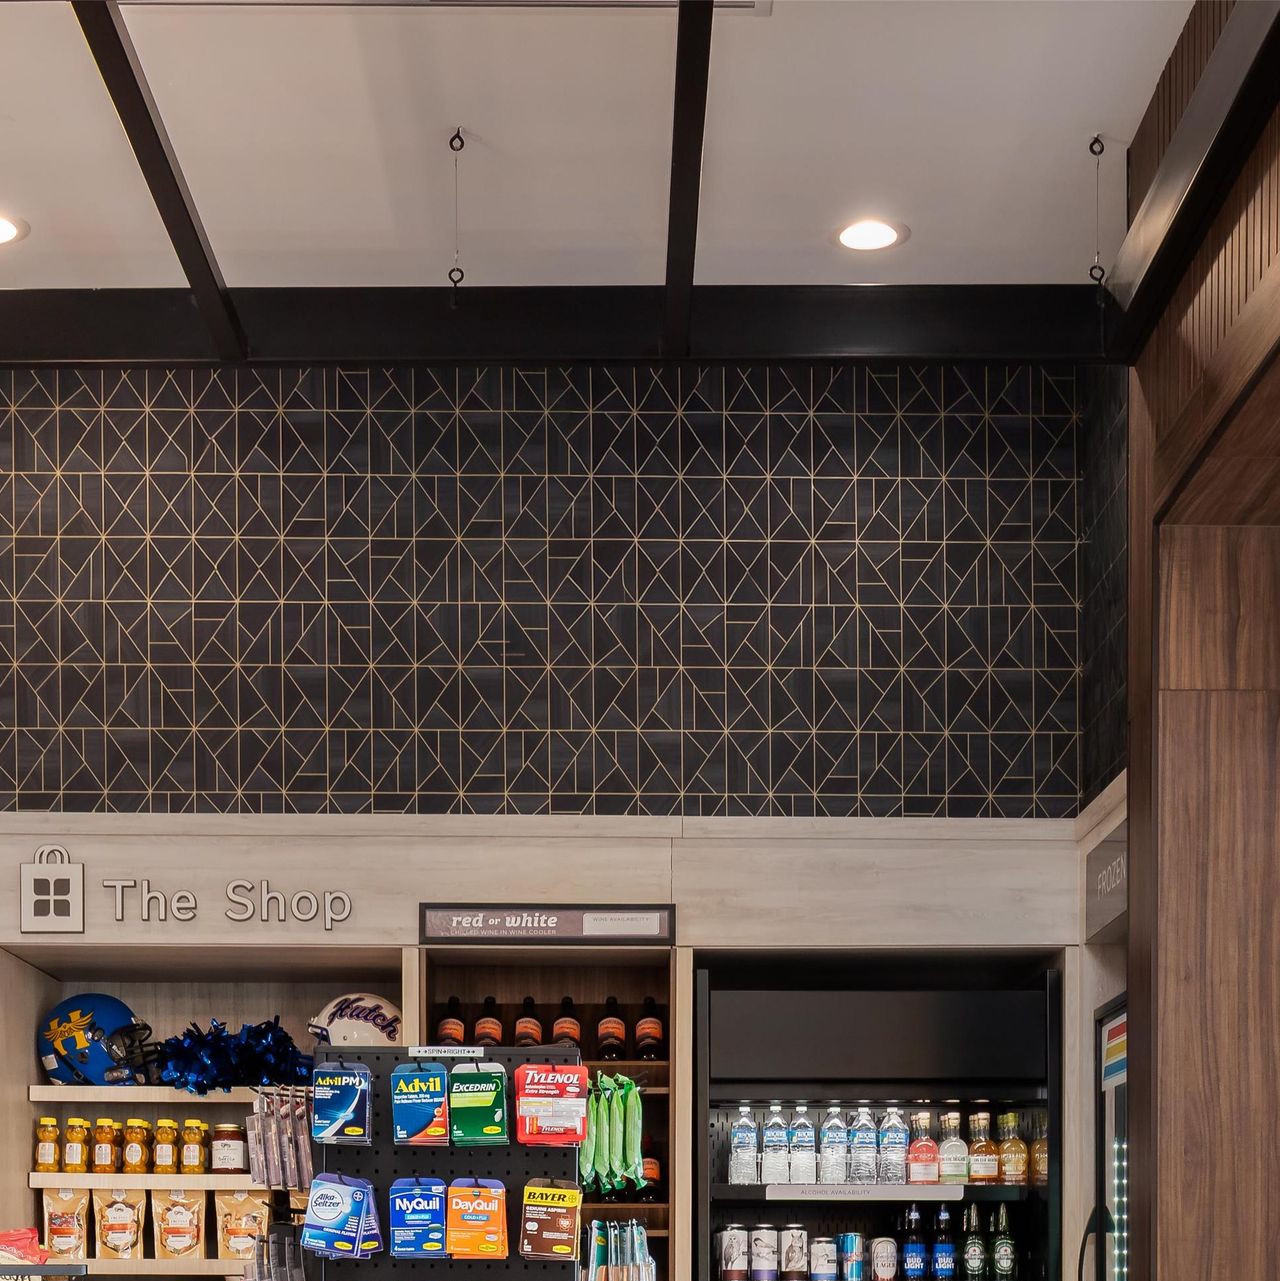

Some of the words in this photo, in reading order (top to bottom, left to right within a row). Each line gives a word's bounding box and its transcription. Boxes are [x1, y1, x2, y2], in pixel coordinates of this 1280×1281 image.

[102, 879, 197, 921] The
[224, 879, 353, 931] Shop
[451, 912, 484, 927] red
[488, 917, 501, 925] or
[505, 912, 558, 927] white
[326, 997, 402, 1042] Hutch
[315, 1076, 341, 1086] Advil
[342, 1076, 360, 1086] PM
[524, 1070, 581, 1084] TYLENOL
[394, 1077, 442, 1094] Advil
[452, 1082, 496, 1092] EXCEDRIN
[319, 1192, 338, 1200] Alka-
[527, 1191, 567, 1202] BAYER
[312, 1200, 342, 1208] Seltzer
[395, 1197, 440, 1213] NyQuil
[451, 1198, 499, 1213] DayQuil
